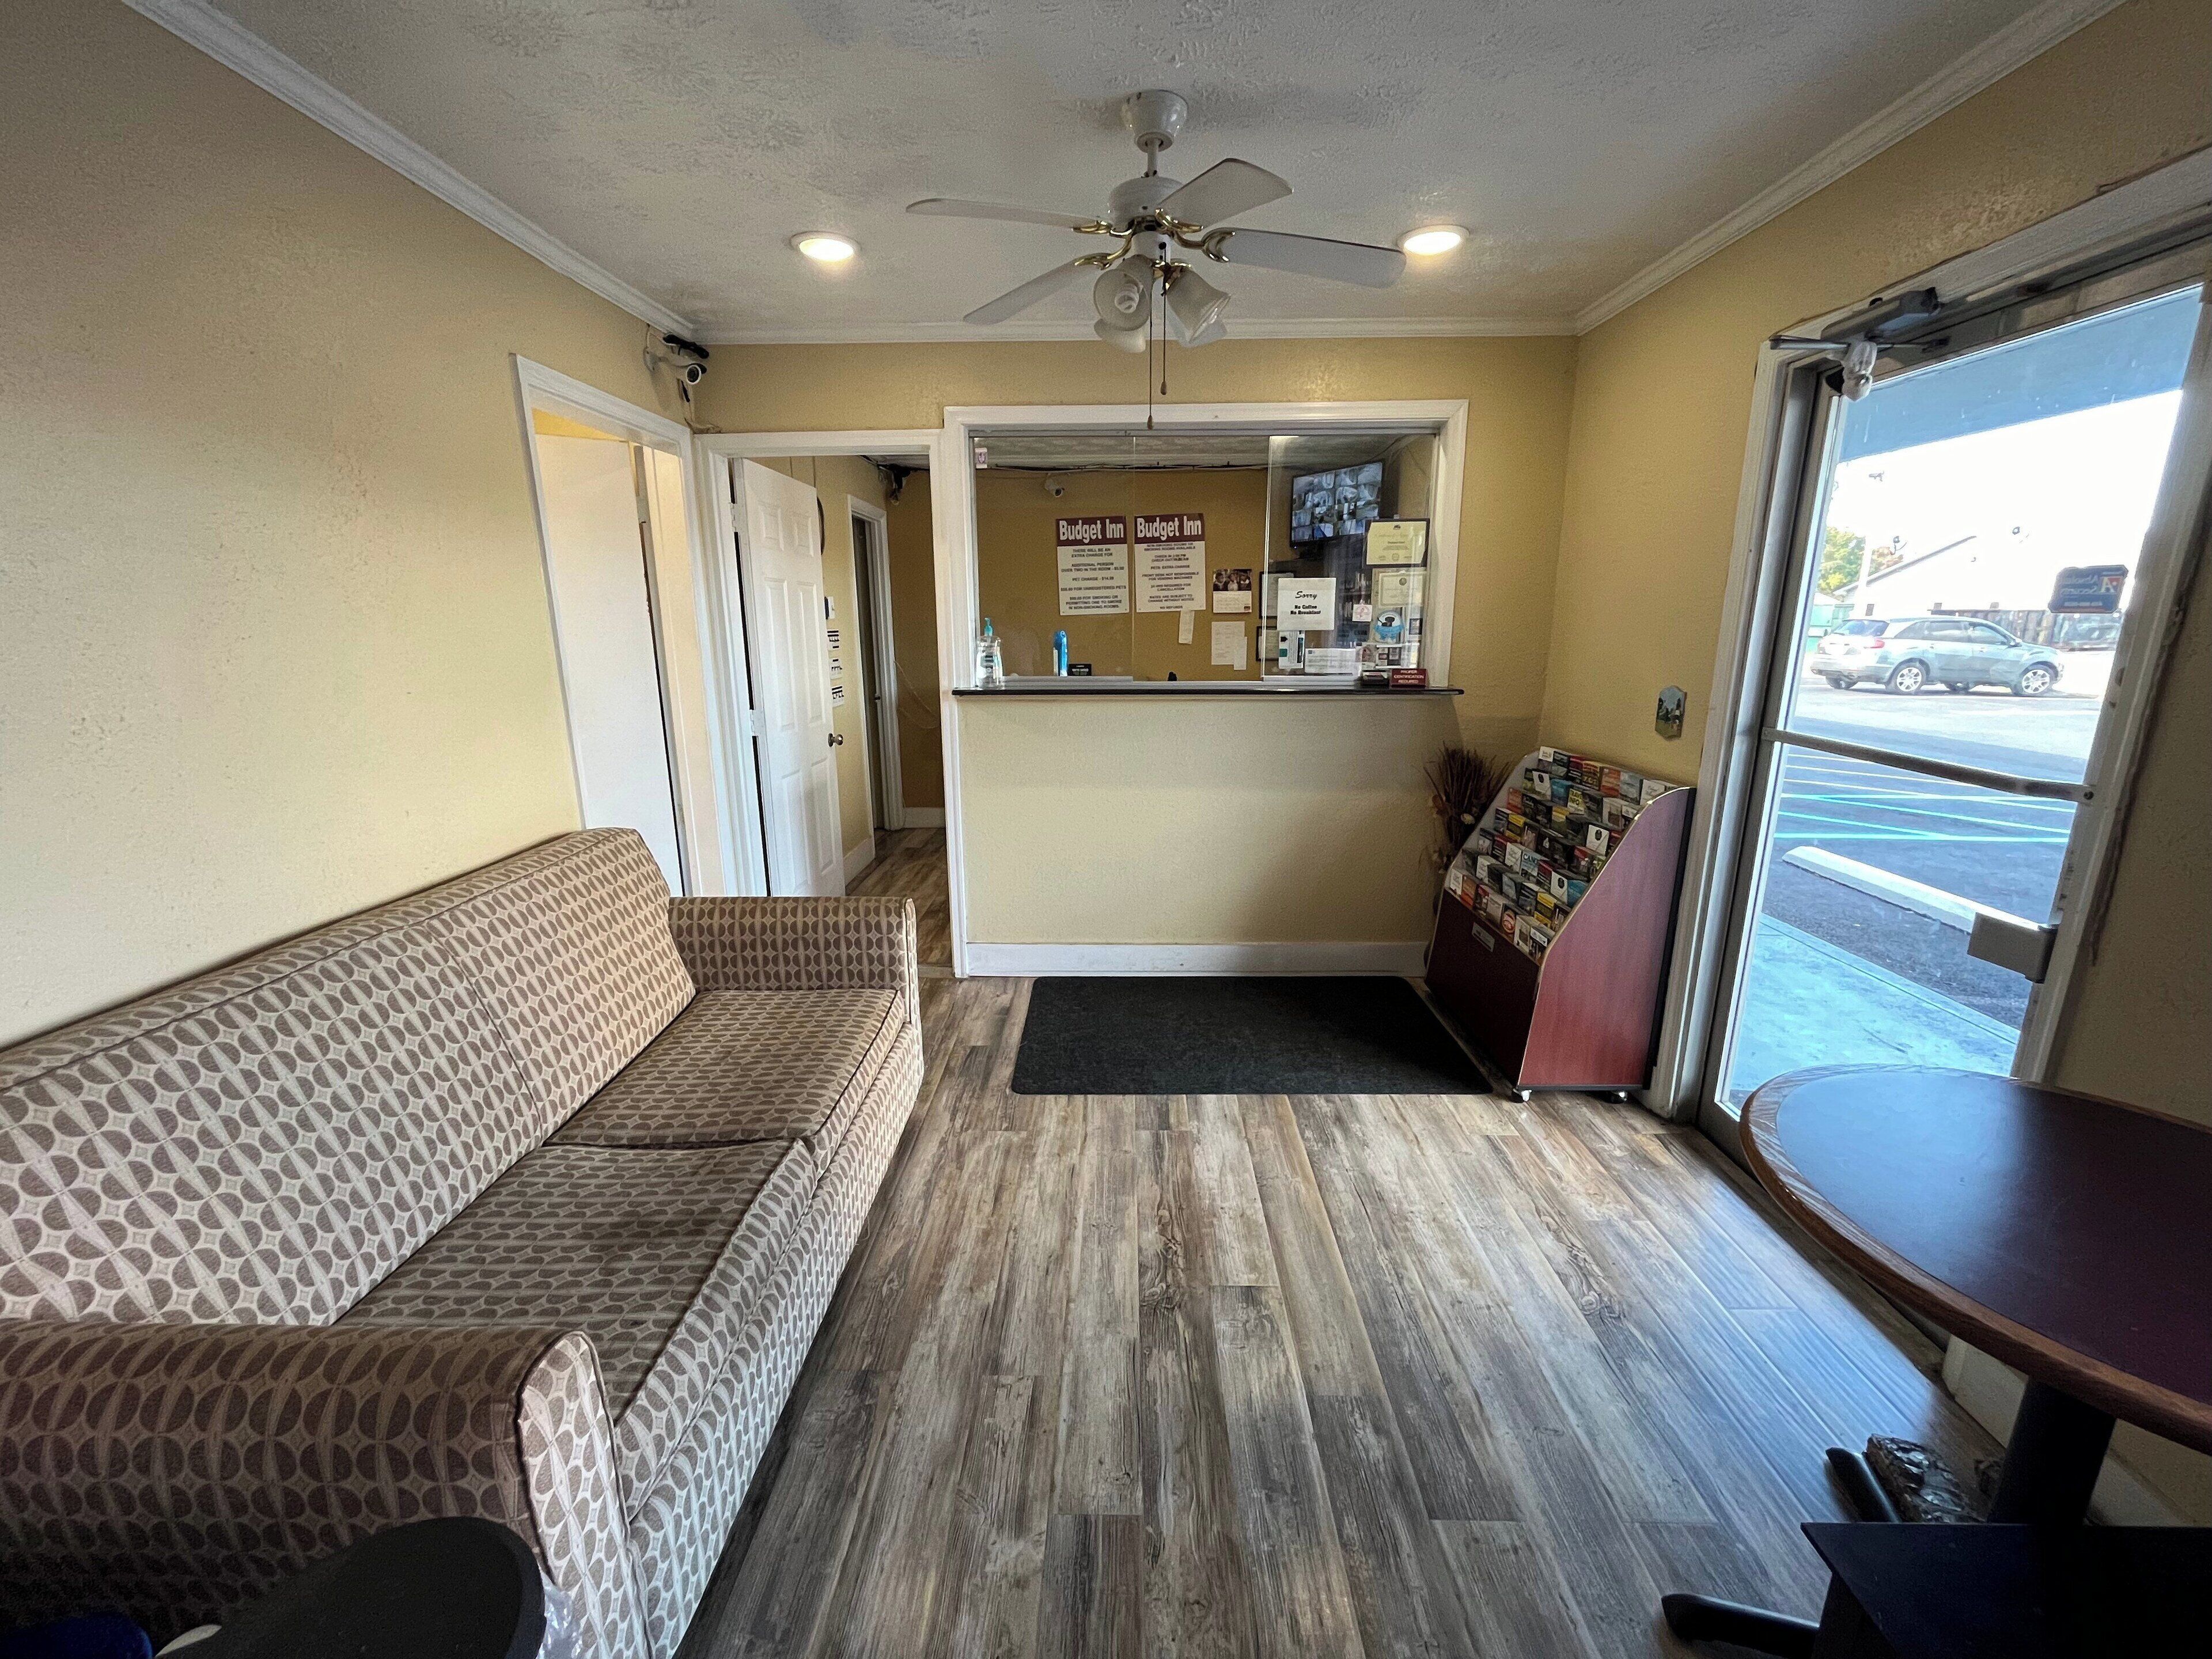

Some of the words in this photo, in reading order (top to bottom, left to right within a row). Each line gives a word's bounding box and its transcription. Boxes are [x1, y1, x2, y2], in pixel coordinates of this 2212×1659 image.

[1059, 520, 1102, 543] Budget
[1105, 518, 1123, 539] Inn
[1137, 517, 1179, 541] Budget
[1183, 516, 1202, 536] Inn
[1295, 590, 1317, 600] Sorry
